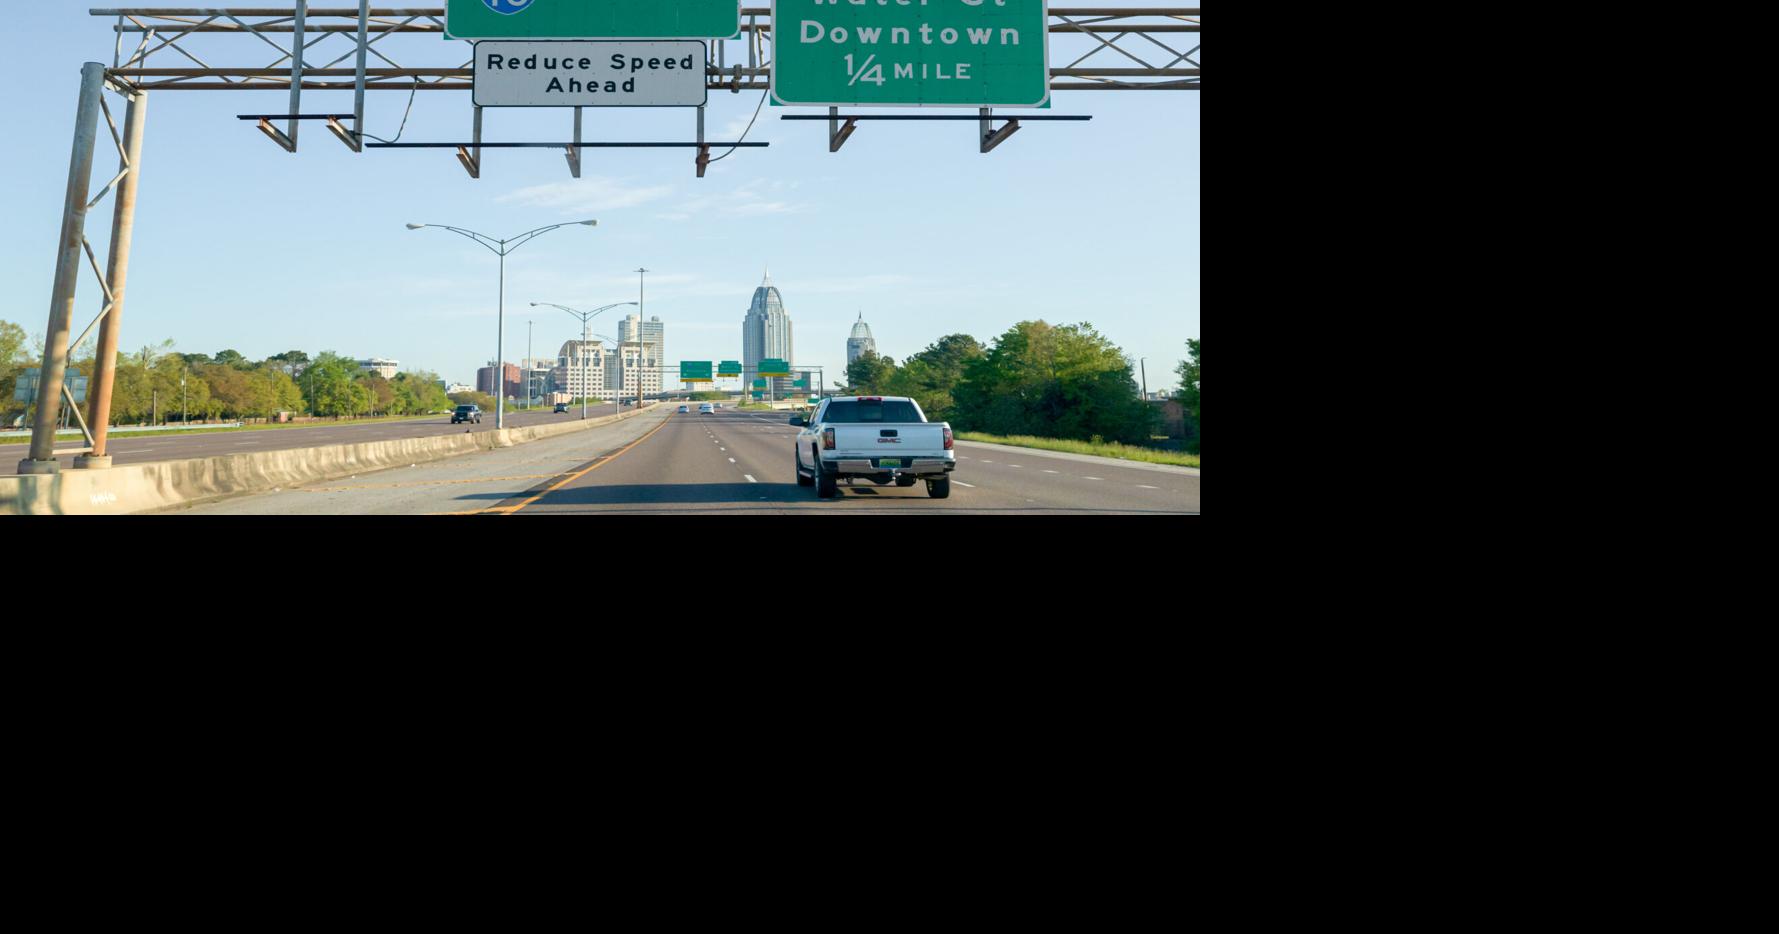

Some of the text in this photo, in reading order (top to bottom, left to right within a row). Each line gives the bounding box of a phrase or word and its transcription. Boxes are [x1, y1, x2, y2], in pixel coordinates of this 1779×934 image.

[800, 19, 1020, 45] Downtown
[487, 53, 694, 74] Reduce Speed
[894, 62, 971, 80] MILE
[545, 76, 635, 93] Ahead
